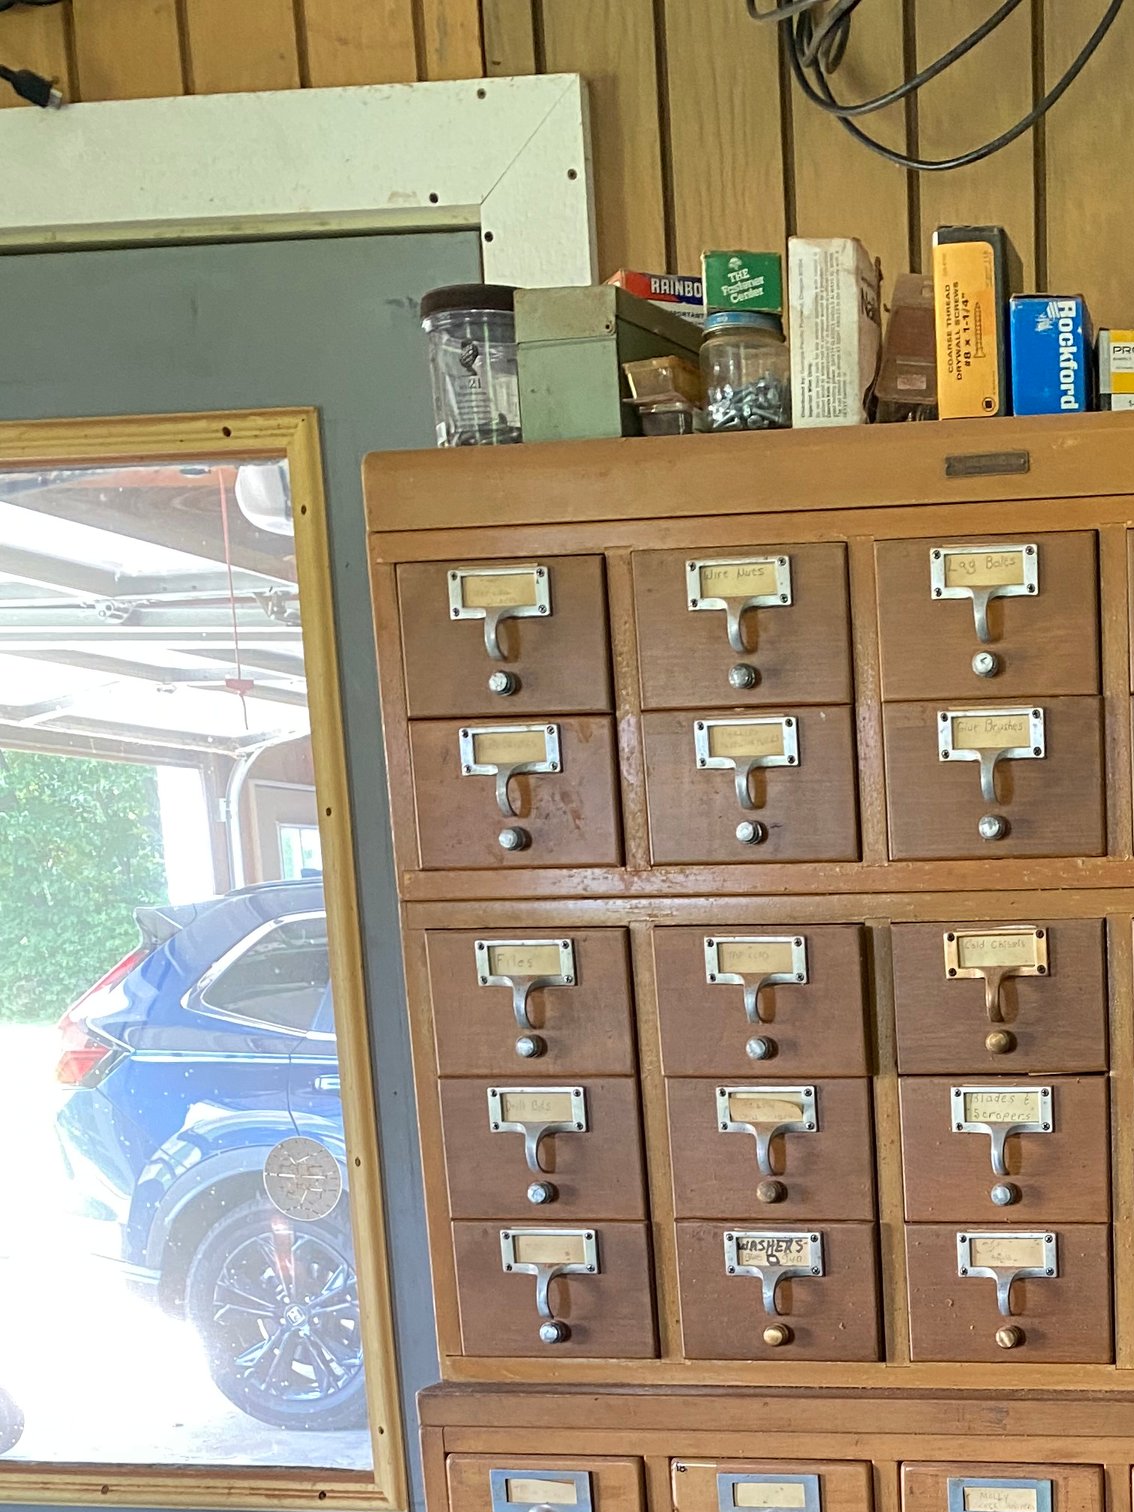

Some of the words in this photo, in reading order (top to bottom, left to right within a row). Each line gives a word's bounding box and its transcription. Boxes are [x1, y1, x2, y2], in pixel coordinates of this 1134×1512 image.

[728, 268, 750, 283] THE
[721, 276, 765, 296] Fastener
[730, 287, 764, 303] Center
[944, 284, 952, 329] THREAD
[953, 281, 962, 326] SCREWS
[961, 292, 970, 333] 1-1/4"
[954, 330, 963, 381] DRYWALL
[964, 352, 972, 367] #8
[1057, 300, 1079, 410] Rockford
[703, 567, 728, 580] Wire
[946, 556, 976, 575] Lag
[496, 953, 533, 968] Files
[739, 1239, 804, 1254] WASHERS
